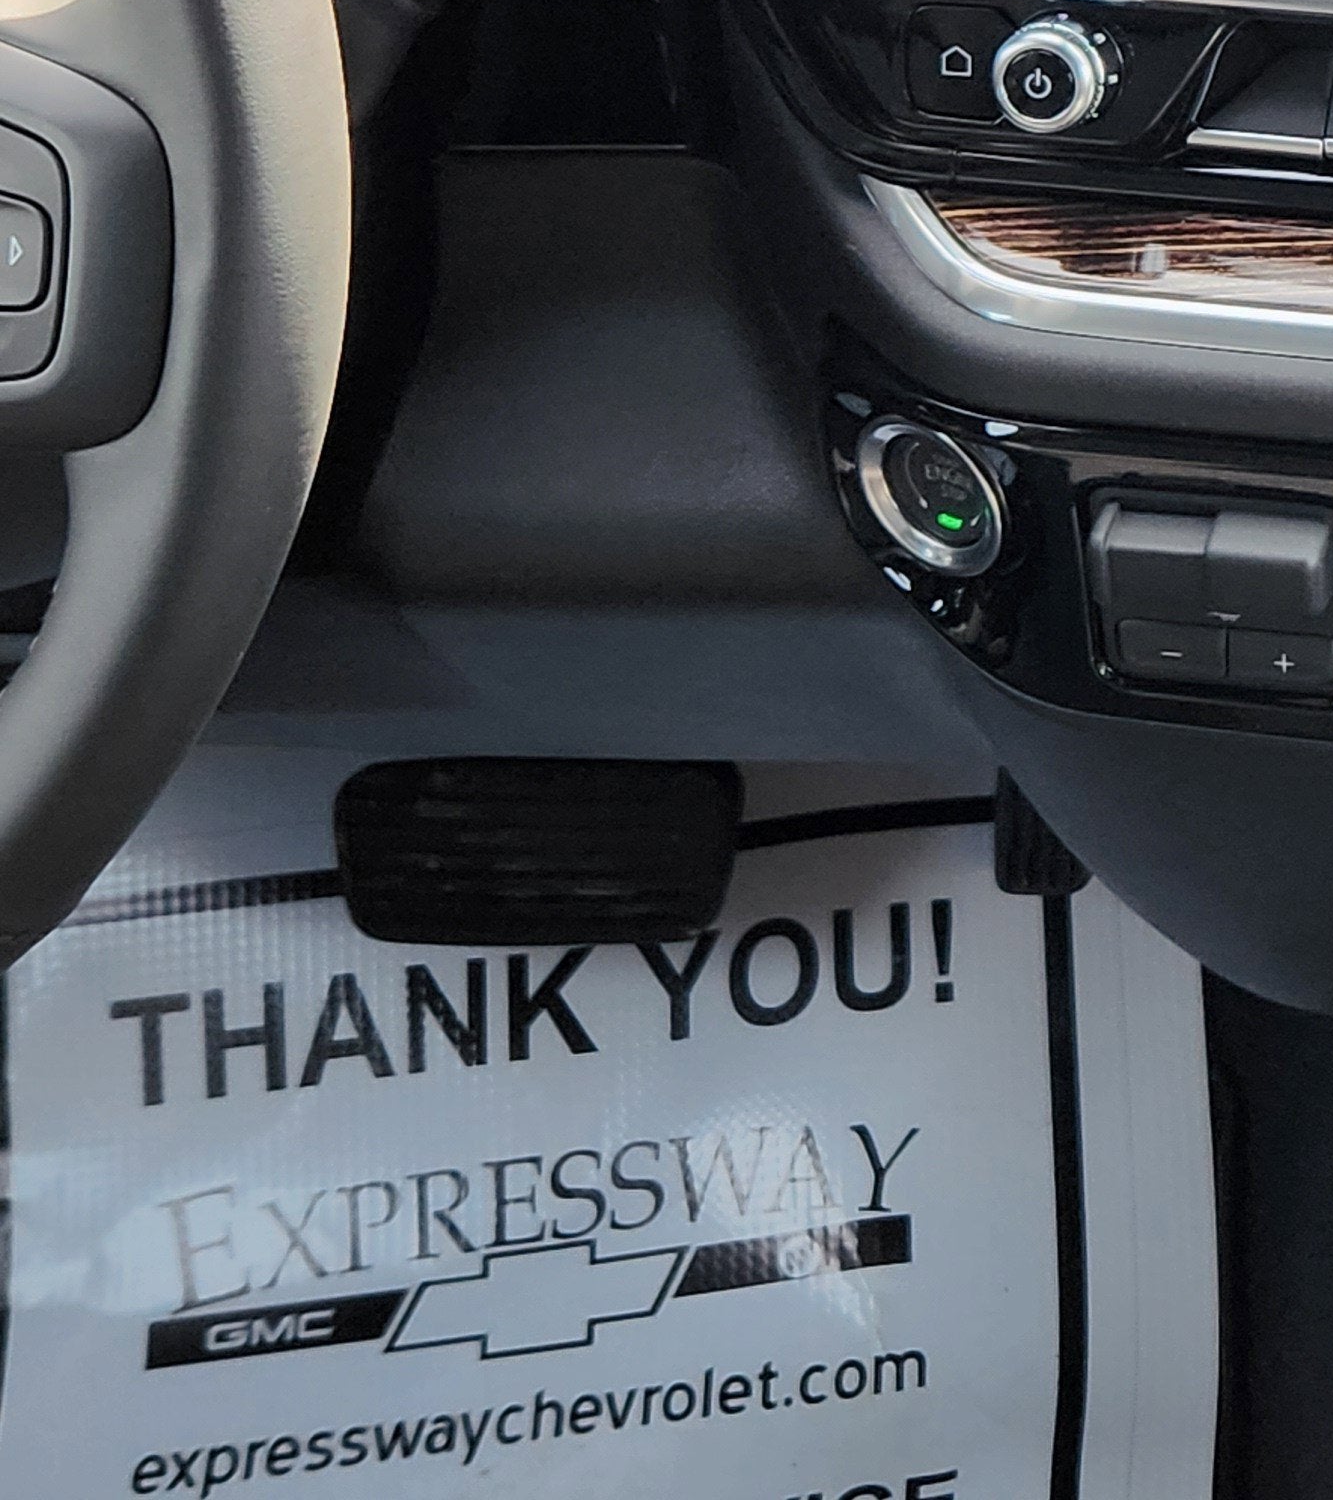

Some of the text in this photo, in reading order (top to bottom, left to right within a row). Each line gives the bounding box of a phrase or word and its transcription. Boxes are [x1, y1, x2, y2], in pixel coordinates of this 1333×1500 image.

[109, 898, 960, 1107] THANK YOU!
[158, 1124, 921, 1315] EXPRESSWAY
[205, 1308, 337, 1352] GMC
[131, 1349, 927, 1499] expresswaychevrolet.com
